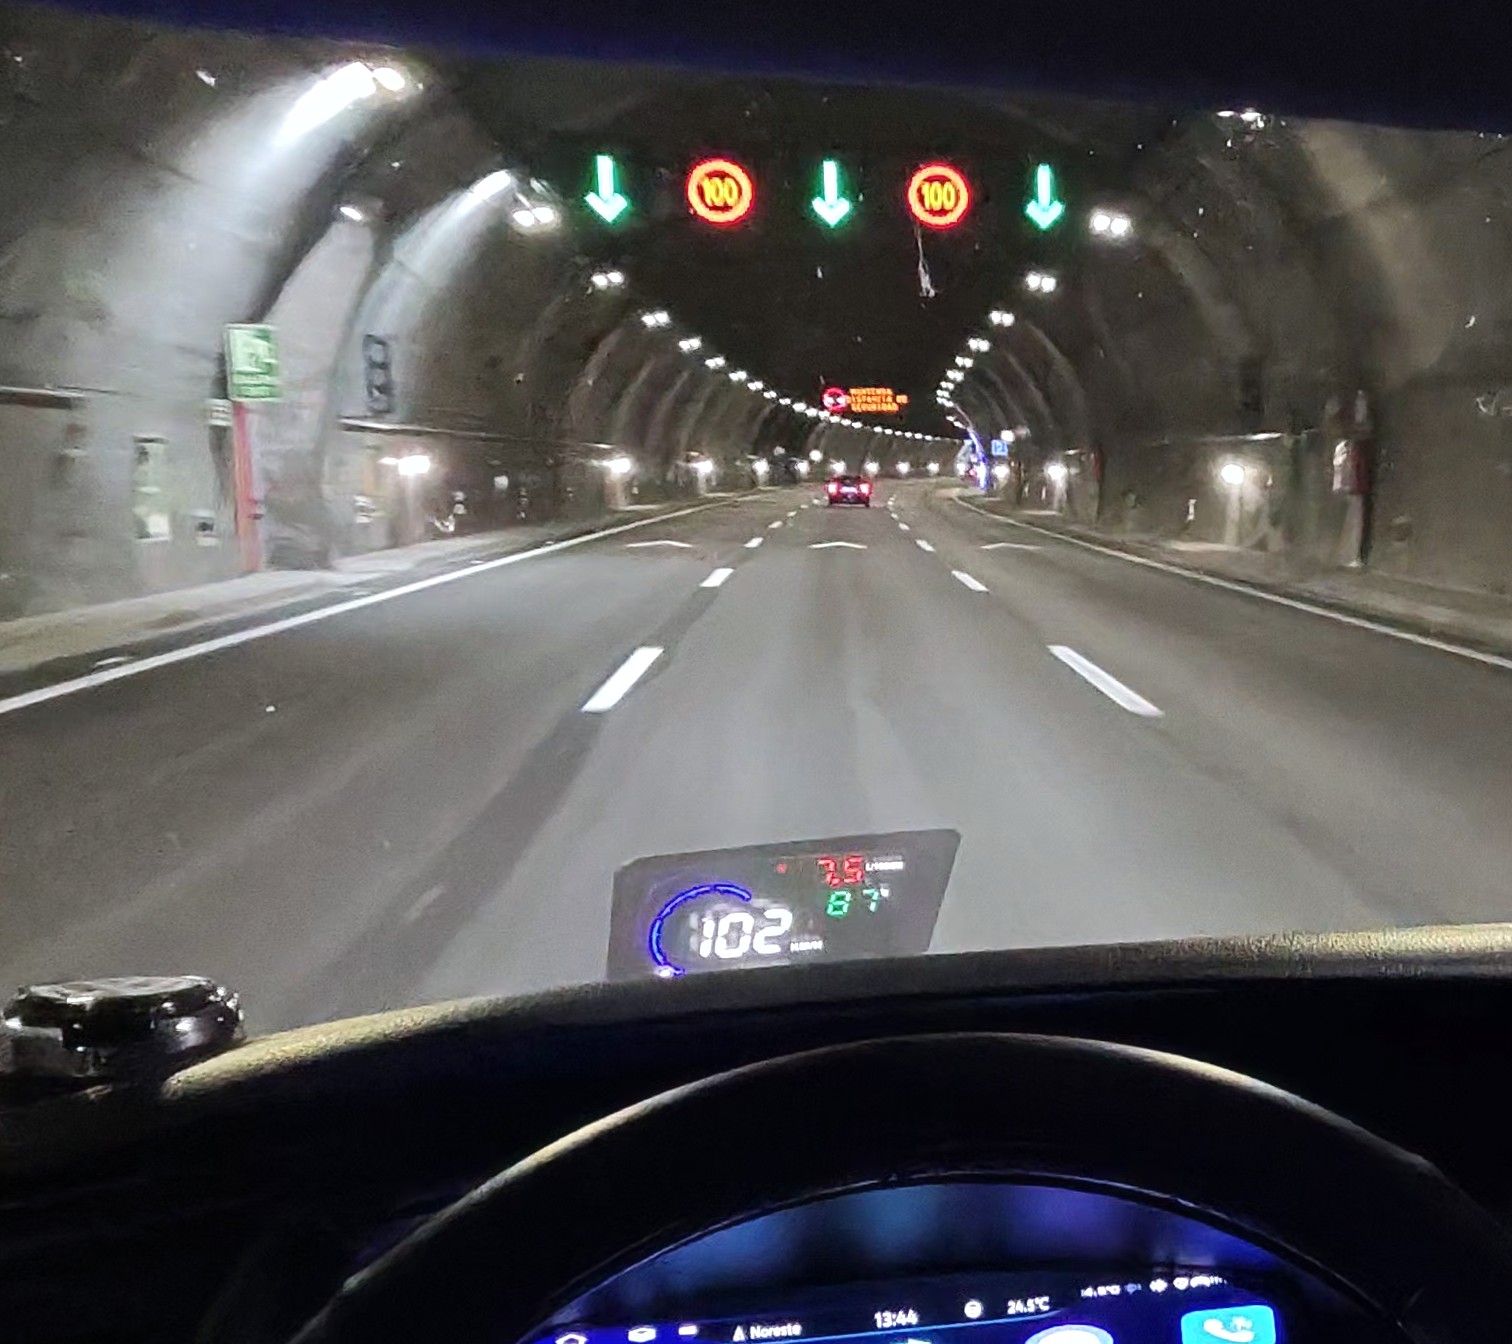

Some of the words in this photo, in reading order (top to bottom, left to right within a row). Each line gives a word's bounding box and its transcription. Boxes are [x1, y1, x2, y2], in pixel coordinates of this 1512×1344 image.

[701, 176, 738, 207] 100
[921, 181, 955, 211] 100
[700, 908, 793, 959] 102
[874, 1309, 918, 1329] 13:44
[1007, 1297, 1049, 1316] 24.5°C
[750, 1323, 802, 1340] Noreste
